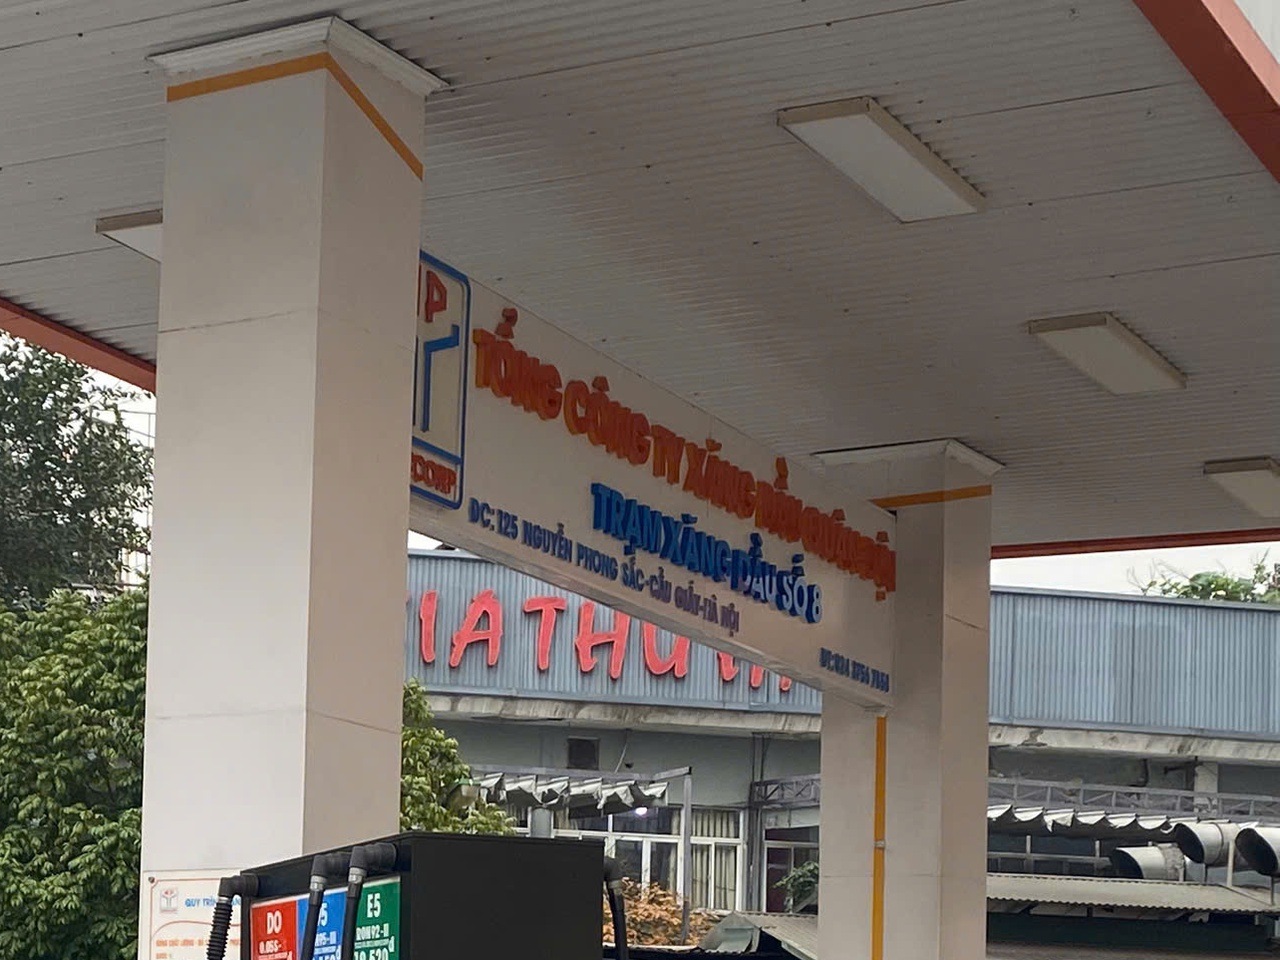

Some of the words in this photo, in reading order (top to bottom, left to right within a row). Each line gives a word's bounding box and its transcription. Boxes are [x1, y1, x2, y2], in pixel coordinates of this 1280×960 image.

[563, 376, 652, 466] CÔNG
[651, 424, 686, 486] TY
[497, 510, 519, 541] 125
[577, 542, 618, 582] PHONG
[591, 483, 663, 556] TRẠM
[660, 513, 732, 584] XĂNG
[730, 532, 777, 604] DẦU
[775, 553, 809, 617] SỐ
[806, 584, 823, 623] 8
[266, 910, 283, 935] DO
[317, 902, 329, 927] 5
[366, 893, 381, 918] E5
